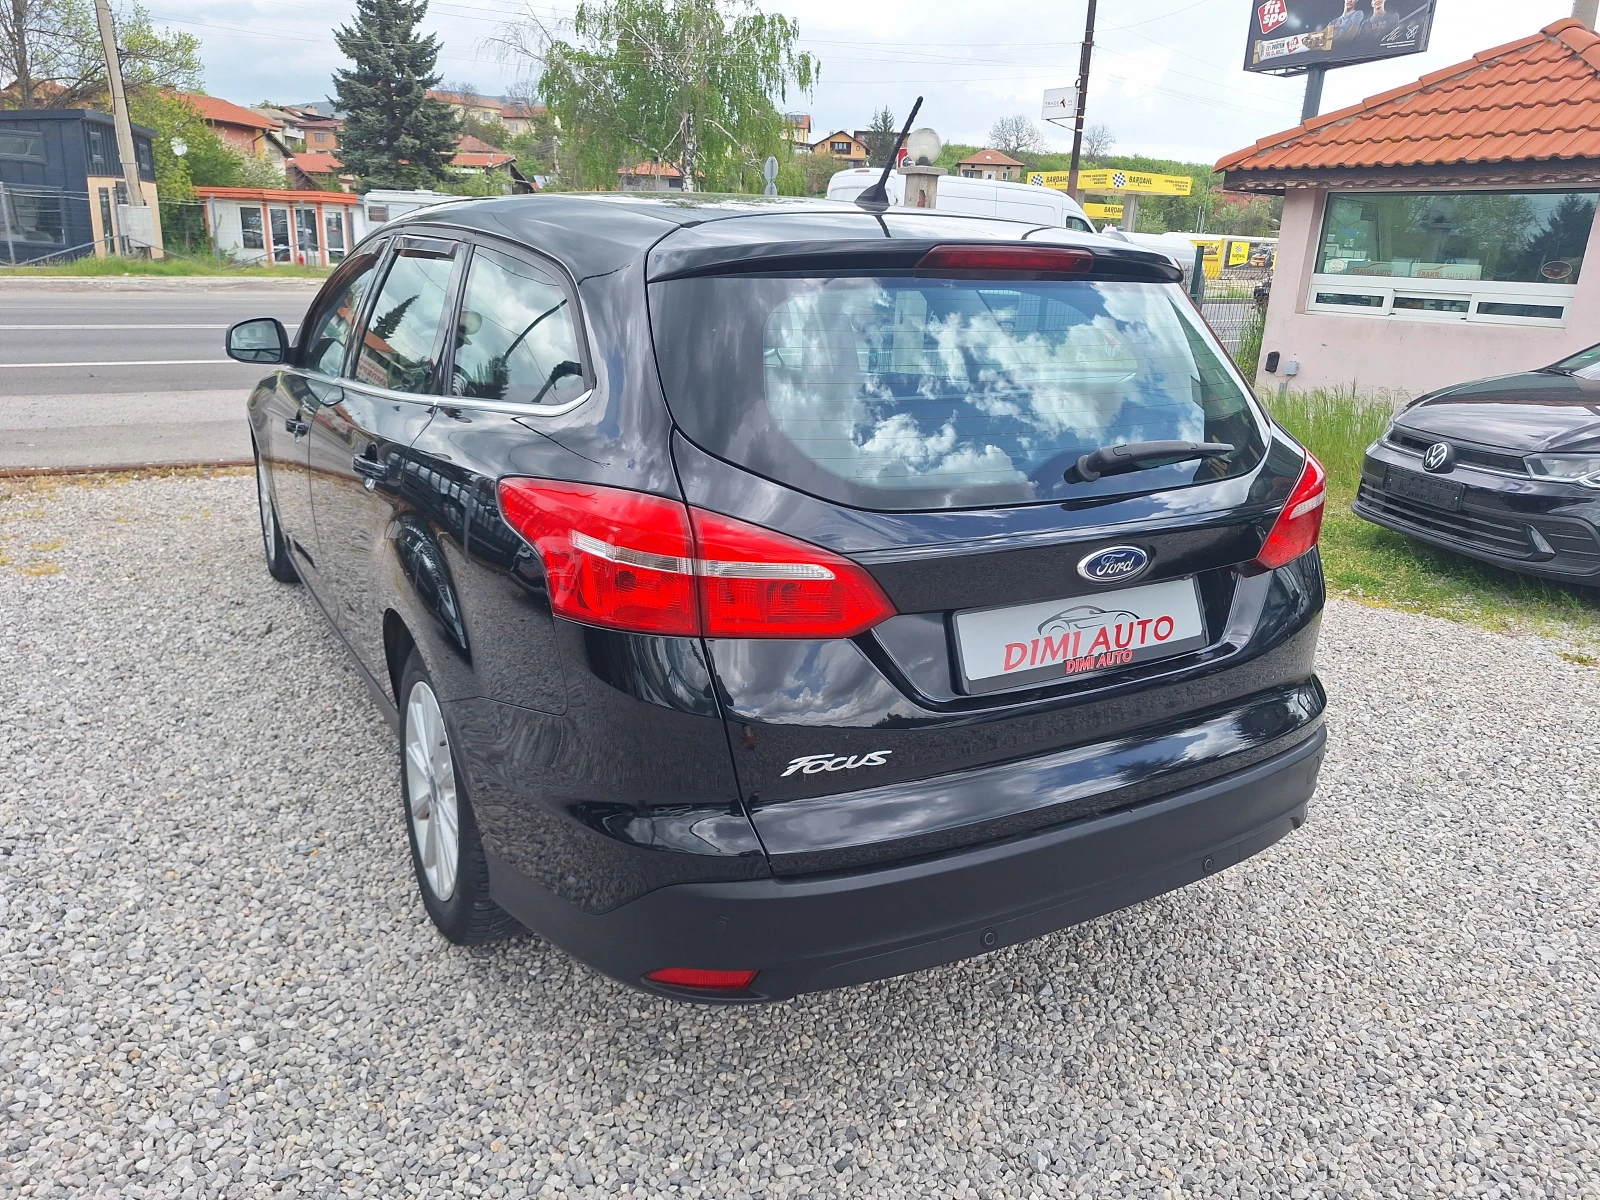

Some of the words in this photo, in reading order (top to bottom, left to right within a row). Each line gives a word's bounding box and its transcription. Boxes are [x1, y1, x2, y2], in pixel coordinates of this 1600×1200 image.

[1264, 0, 1281, 14] fit
[1263, 12, 1288, 27] spo
[1129, 175, 1153, 187] BARDAHL
[1104, 206, 1123, 216] BARDAH
[1417, 270, 1443, 278] KRAKRA
[1096, 553, 1135, 575] Ford
[1003, 630, 1082, 671] DIMI
[1090, 615, 1174, 654] AUTO
[1065, 656, 1095, 674] DIMI
[1096, 649, 1133, 668] AUTO
[780, 750, 892, 777] FOCUS
